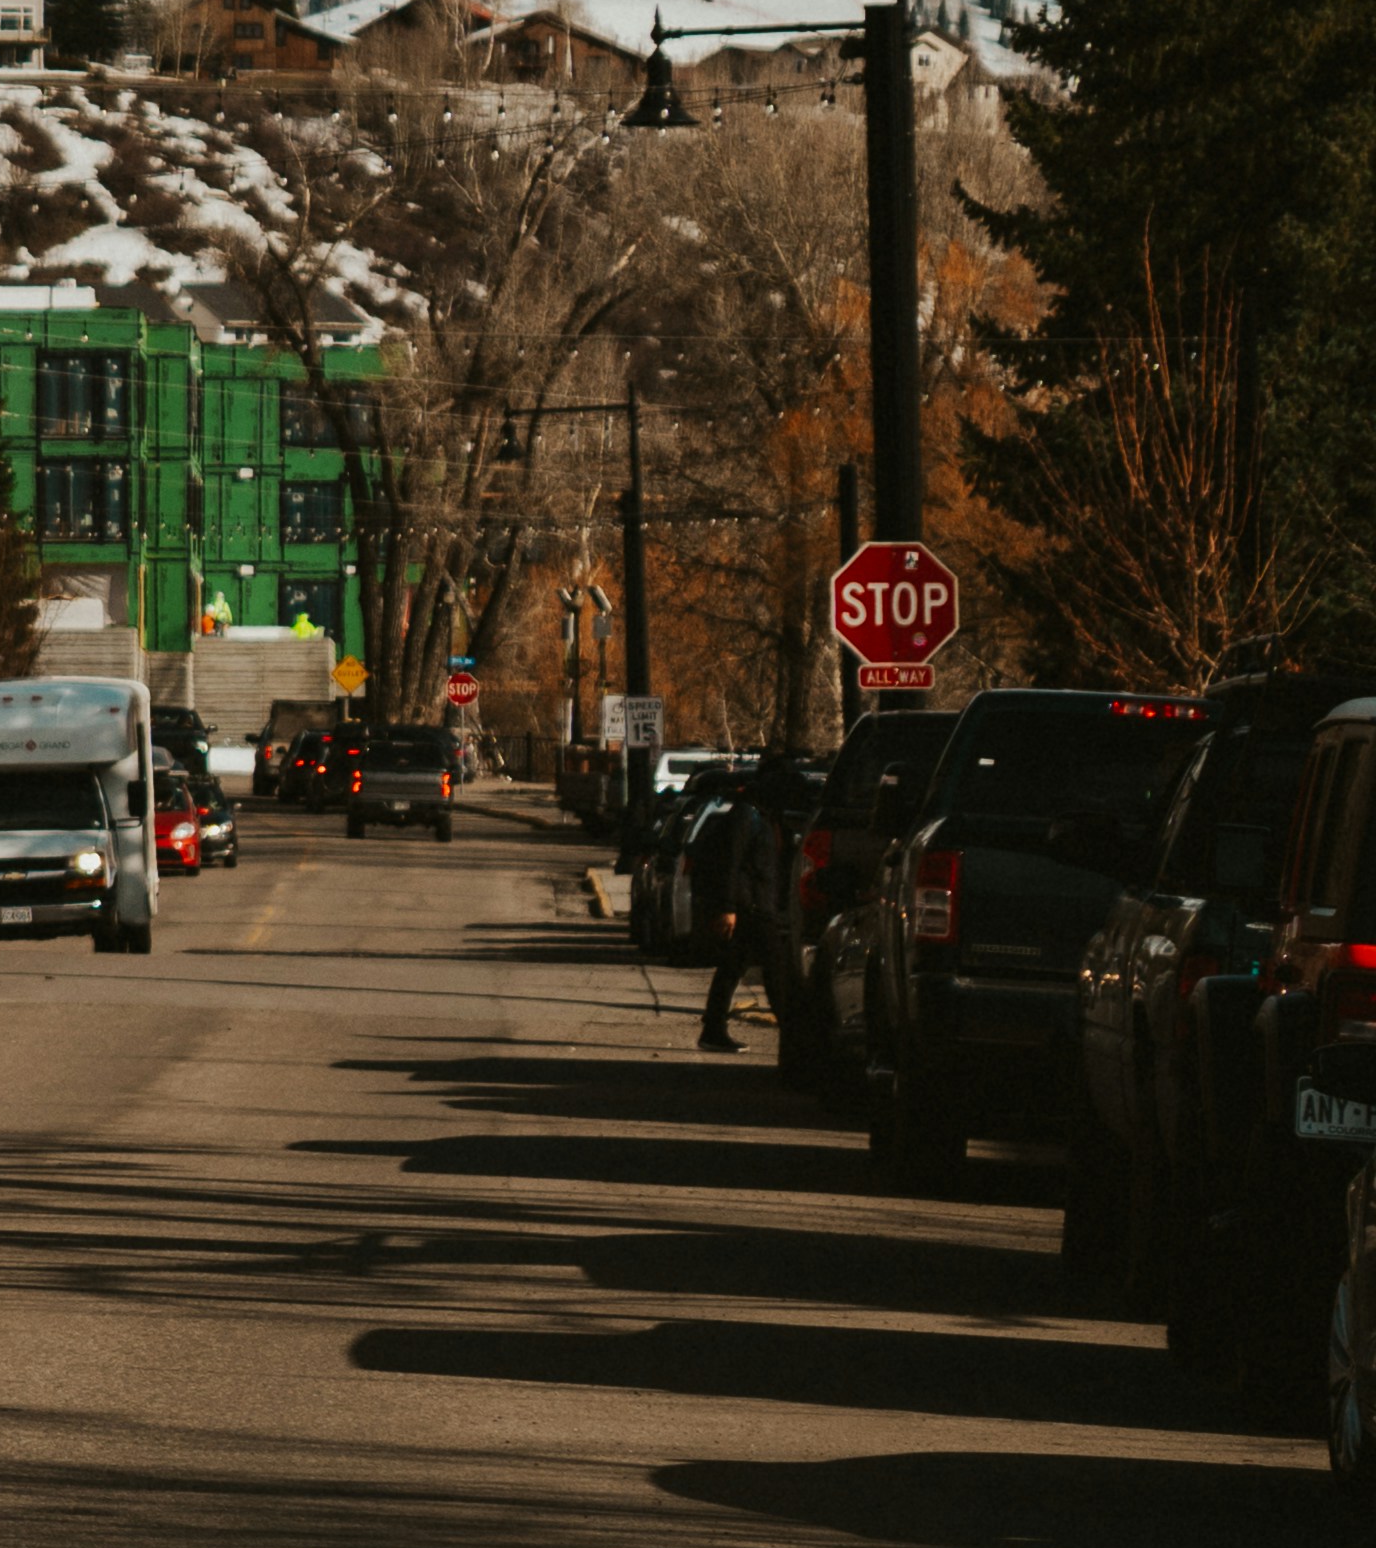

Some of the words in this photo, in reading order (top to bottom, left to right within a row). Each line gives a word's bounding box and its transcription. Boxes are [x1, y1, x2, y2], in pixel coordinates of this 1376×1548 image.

[841, 581, 949, 627] STOP
[866, 670, 892, 684] ALL
[898, 669, 926, 684] WAY
[448, 682, 477, 696] STOP
[628, 701, 661, 710] SPEED
[632, 711, 657, 721] LIMIT
[634, 722, 657, 741] 15
